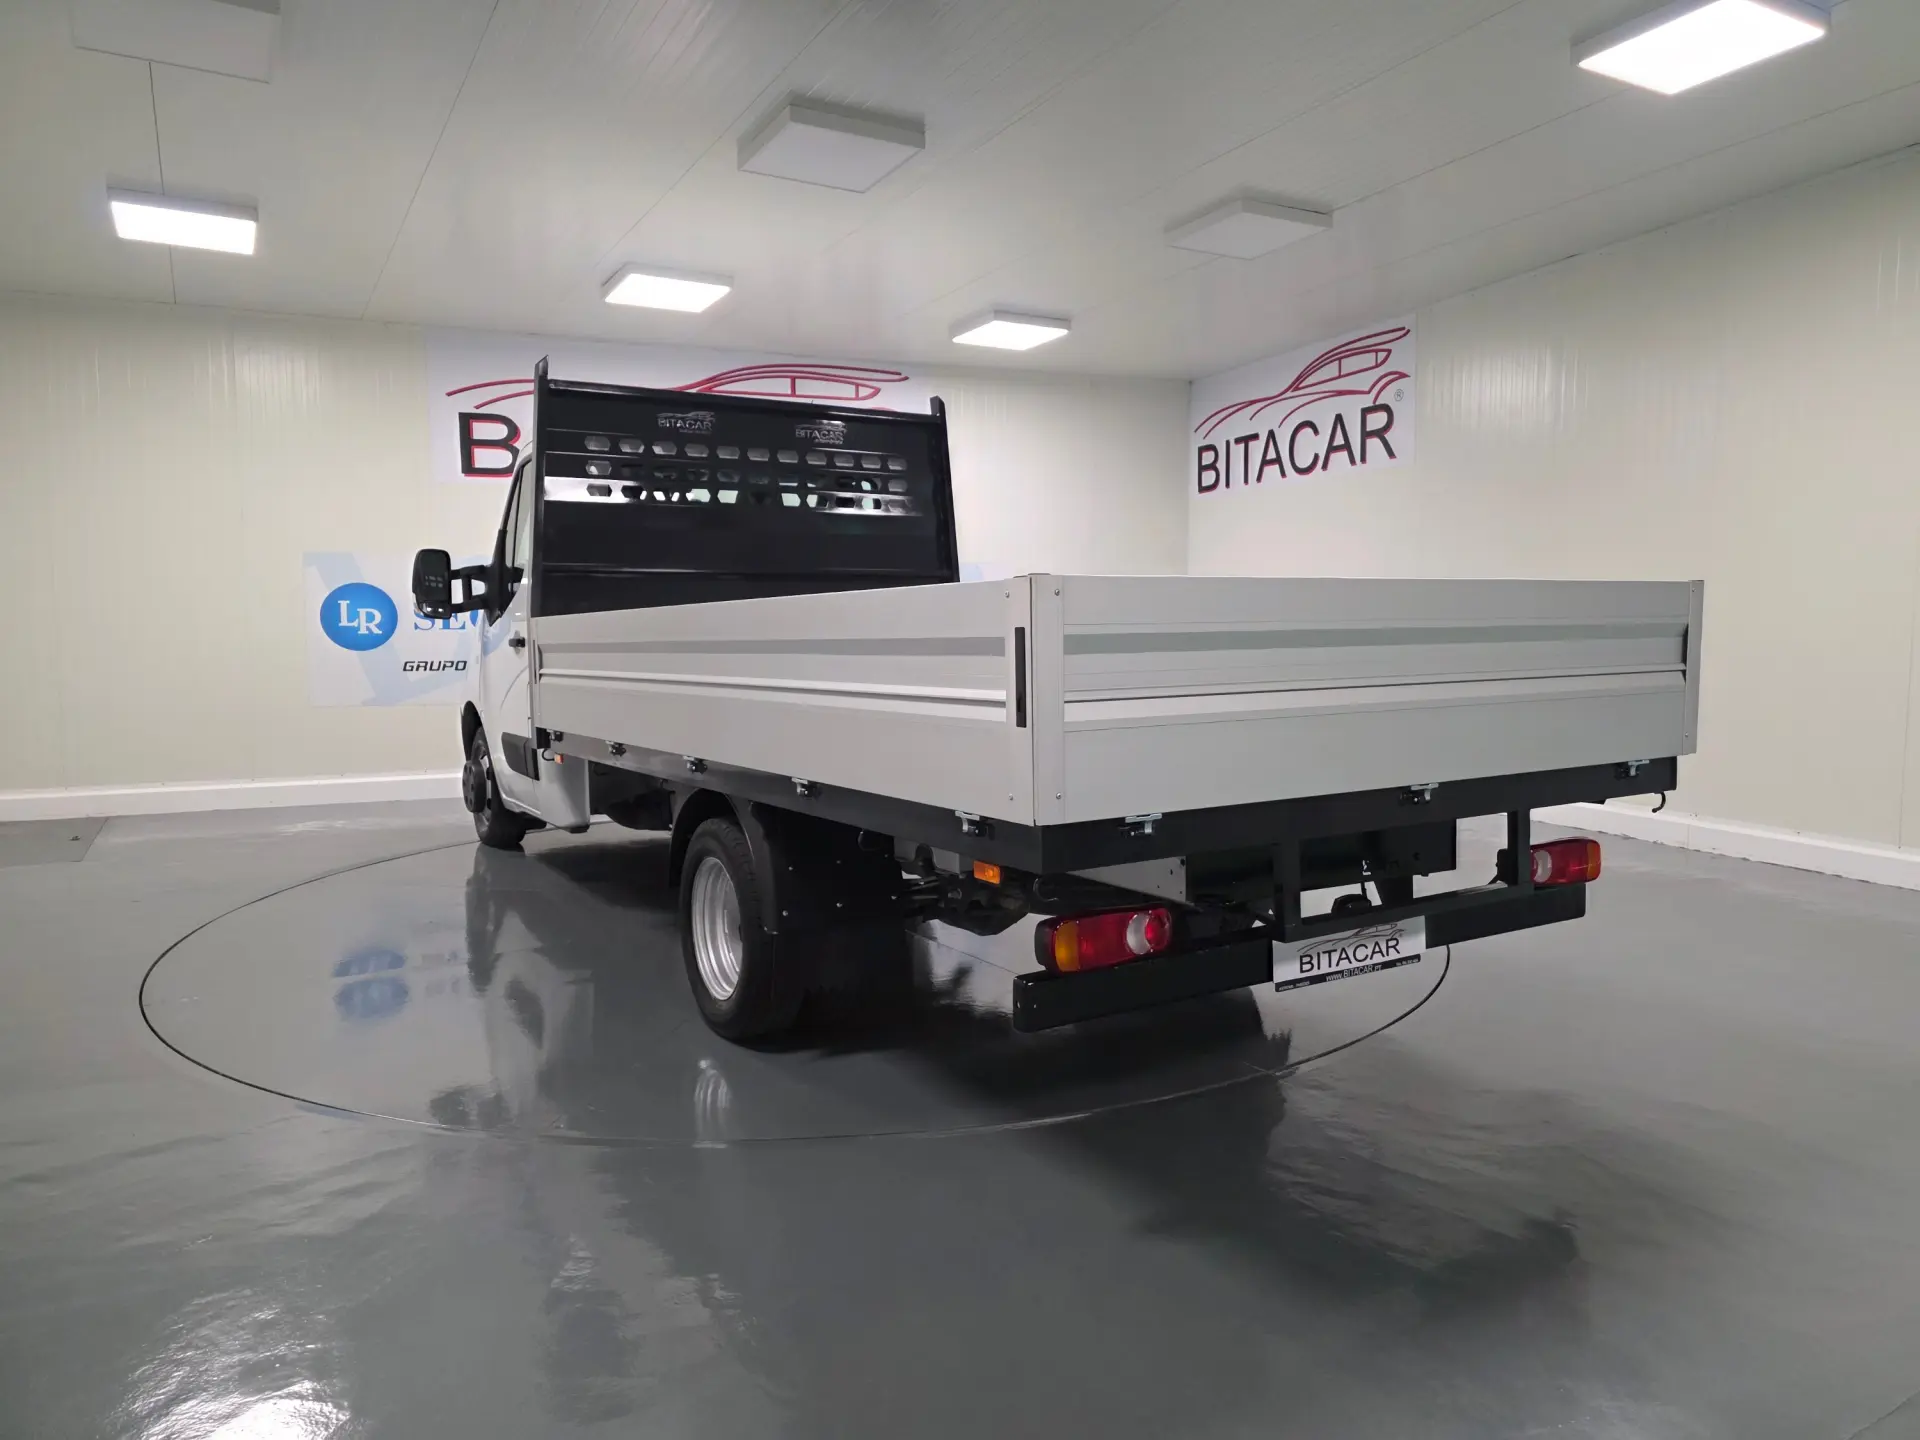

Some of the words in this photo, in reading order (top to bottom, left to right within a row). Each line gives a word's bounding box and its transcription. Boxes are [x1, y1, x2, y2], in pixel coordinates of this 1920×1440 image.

[658, 418, 712, 431] BITACAR
[795, 429, 844, 441] BITACAR
[1197, 403, 1397, 494] BITACAR
[337, 600, 383, 635] LR
[402, 660, 468, 673] GRUPO
[1300, 937, 1401, 974] BITACAR
